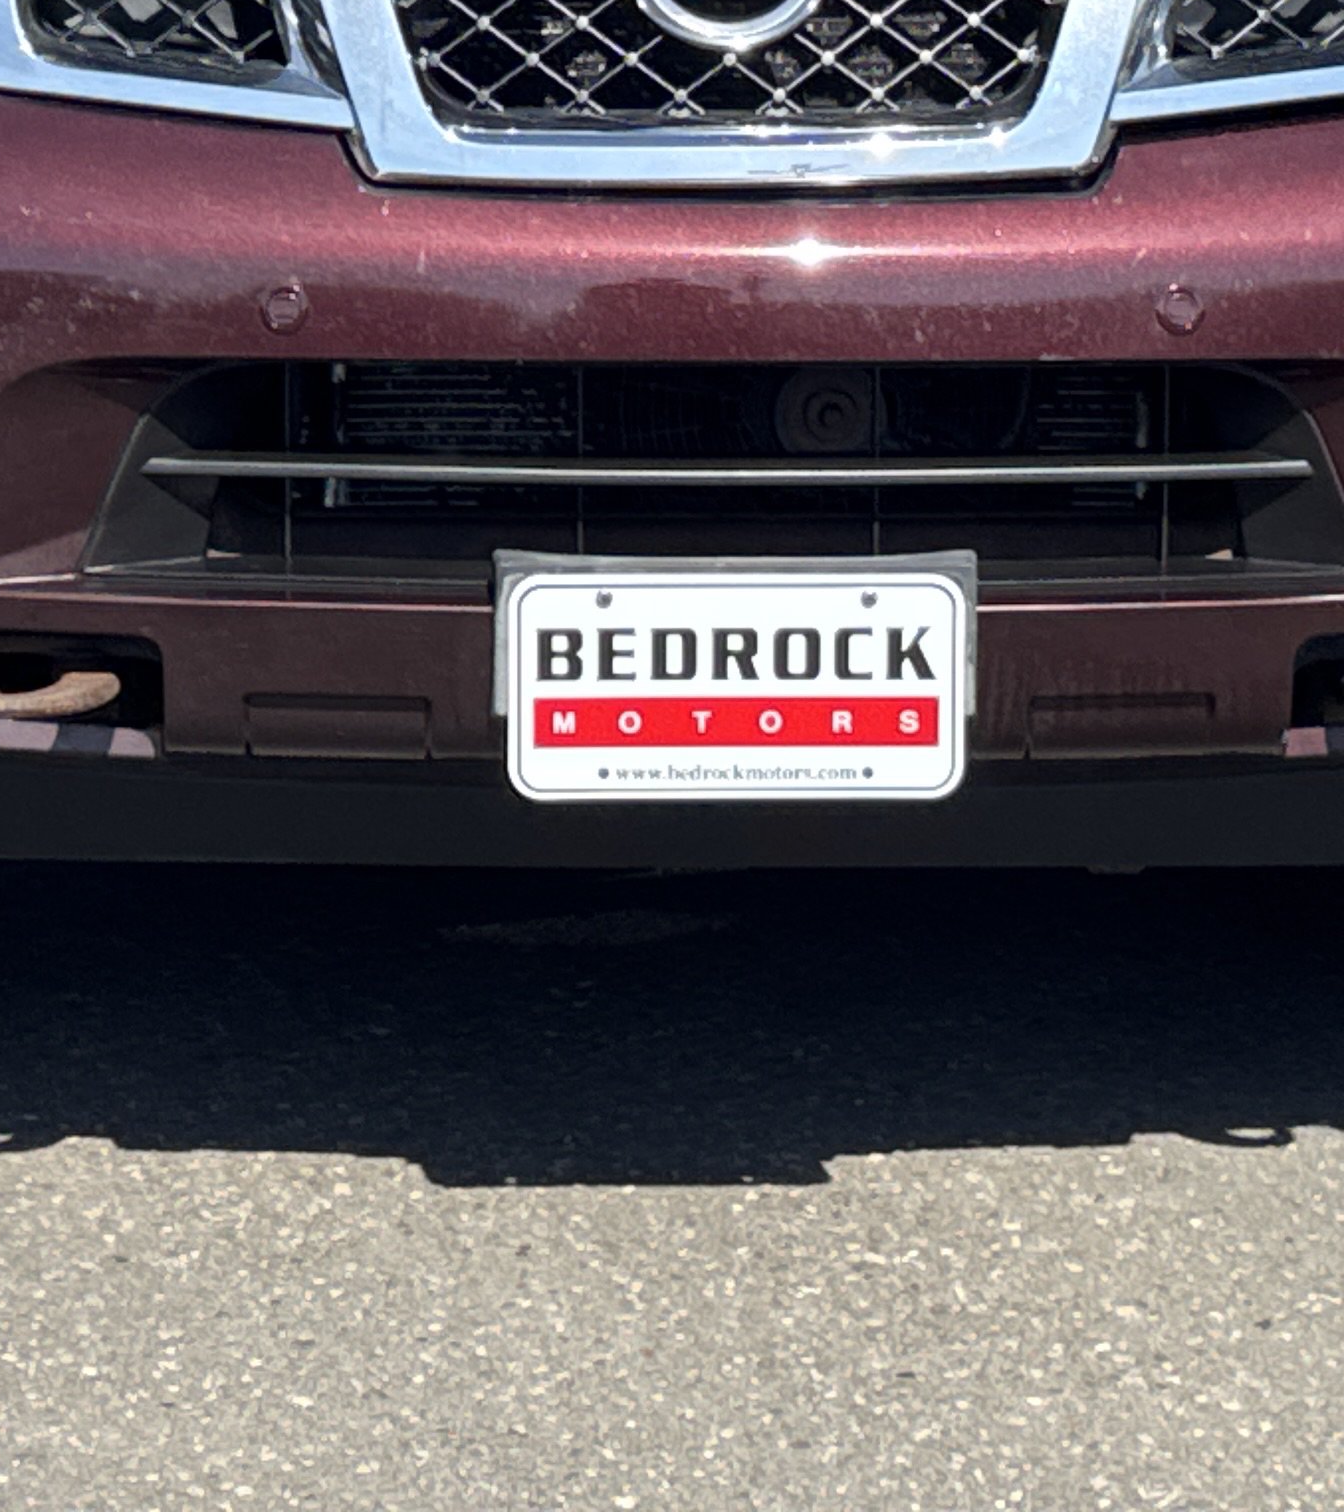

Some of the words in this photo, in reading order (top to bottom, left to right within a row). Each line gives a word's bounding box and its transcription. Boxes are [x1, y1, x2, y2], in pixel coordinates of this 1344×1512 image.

[535, 626, 937, 682] BEDROCK
[552, 710, 920, 735] MOTORS
[616, 764, 857, 782] www.bedrockmotors.com
